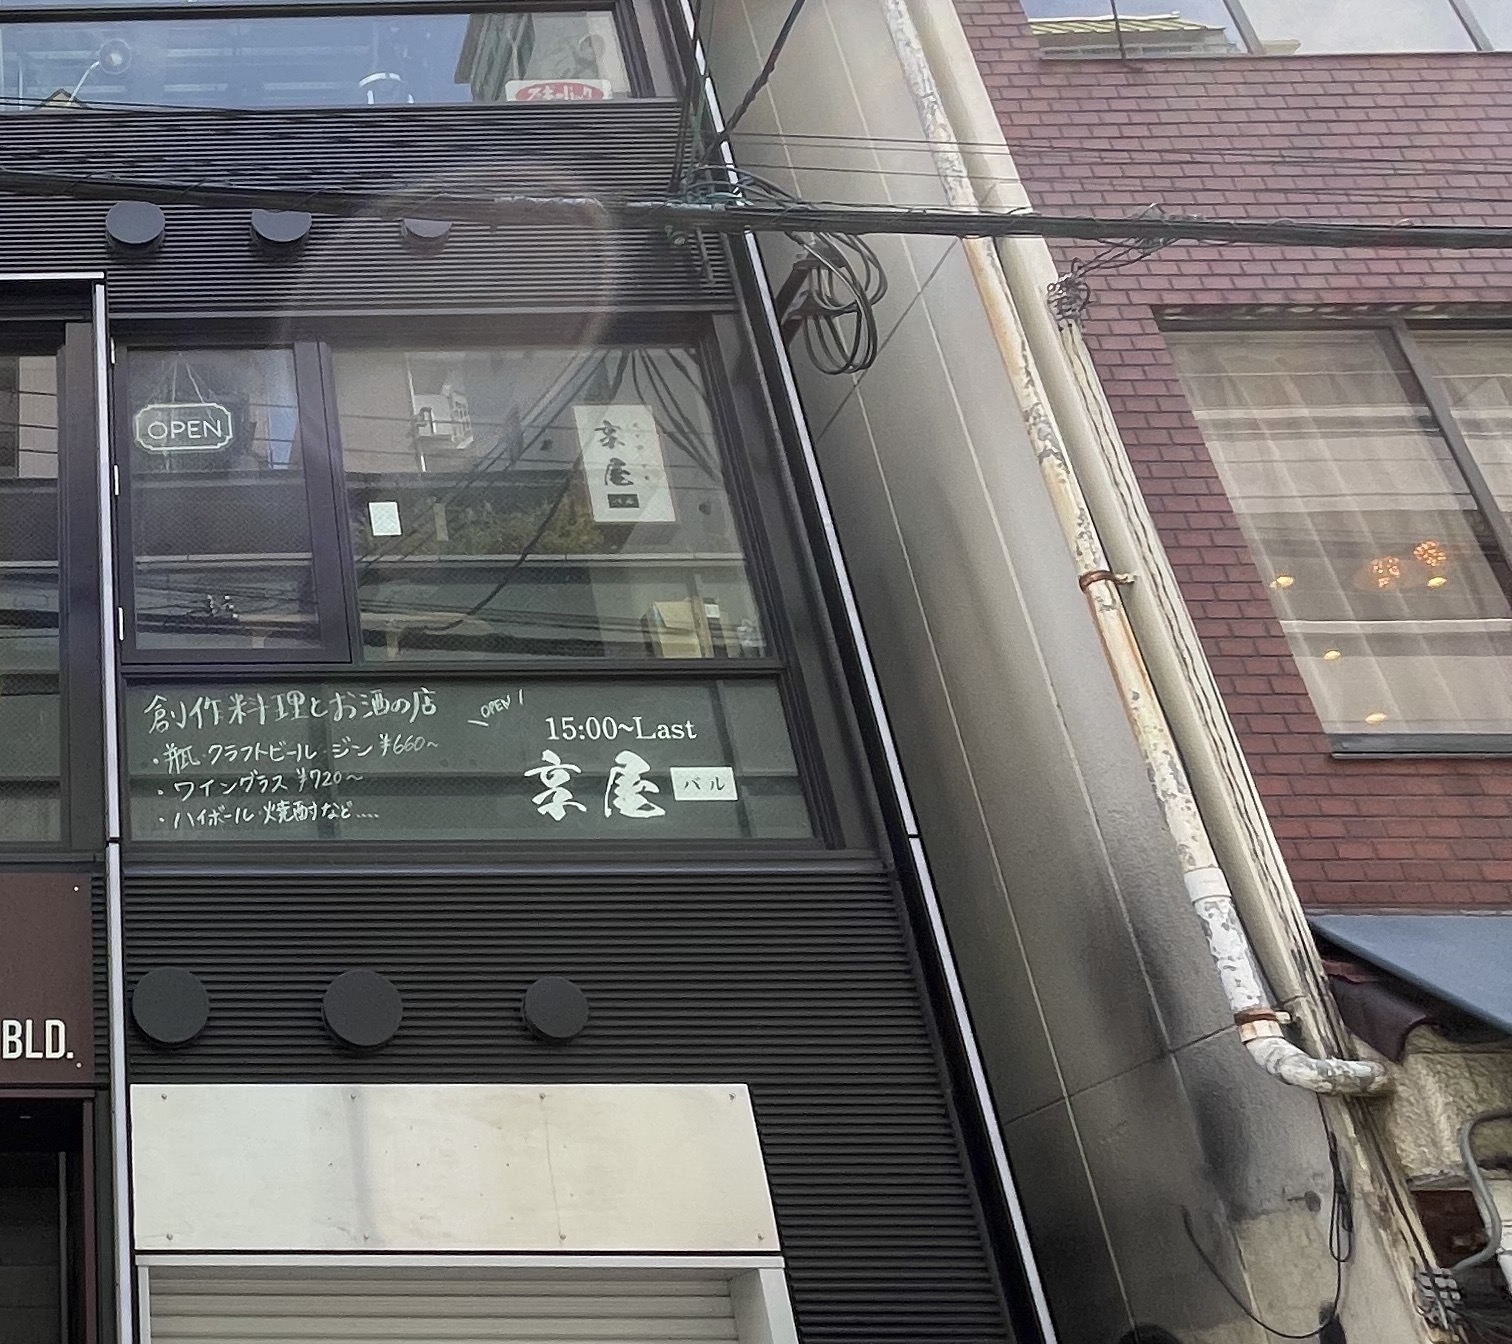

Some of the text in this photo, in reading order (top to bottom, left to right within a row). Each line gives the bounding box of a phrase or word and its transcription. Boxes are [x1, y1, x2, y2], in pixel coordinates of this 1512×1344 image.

[148, 420, 222, 439] OPEN
[144, 687, 437, 734] 創作料理とお酒の店
[544, 716, 697, 740] 15:00~Last
[683, 775, 727, 793] バル
[2, 1018, 74, 1060] BLD.
